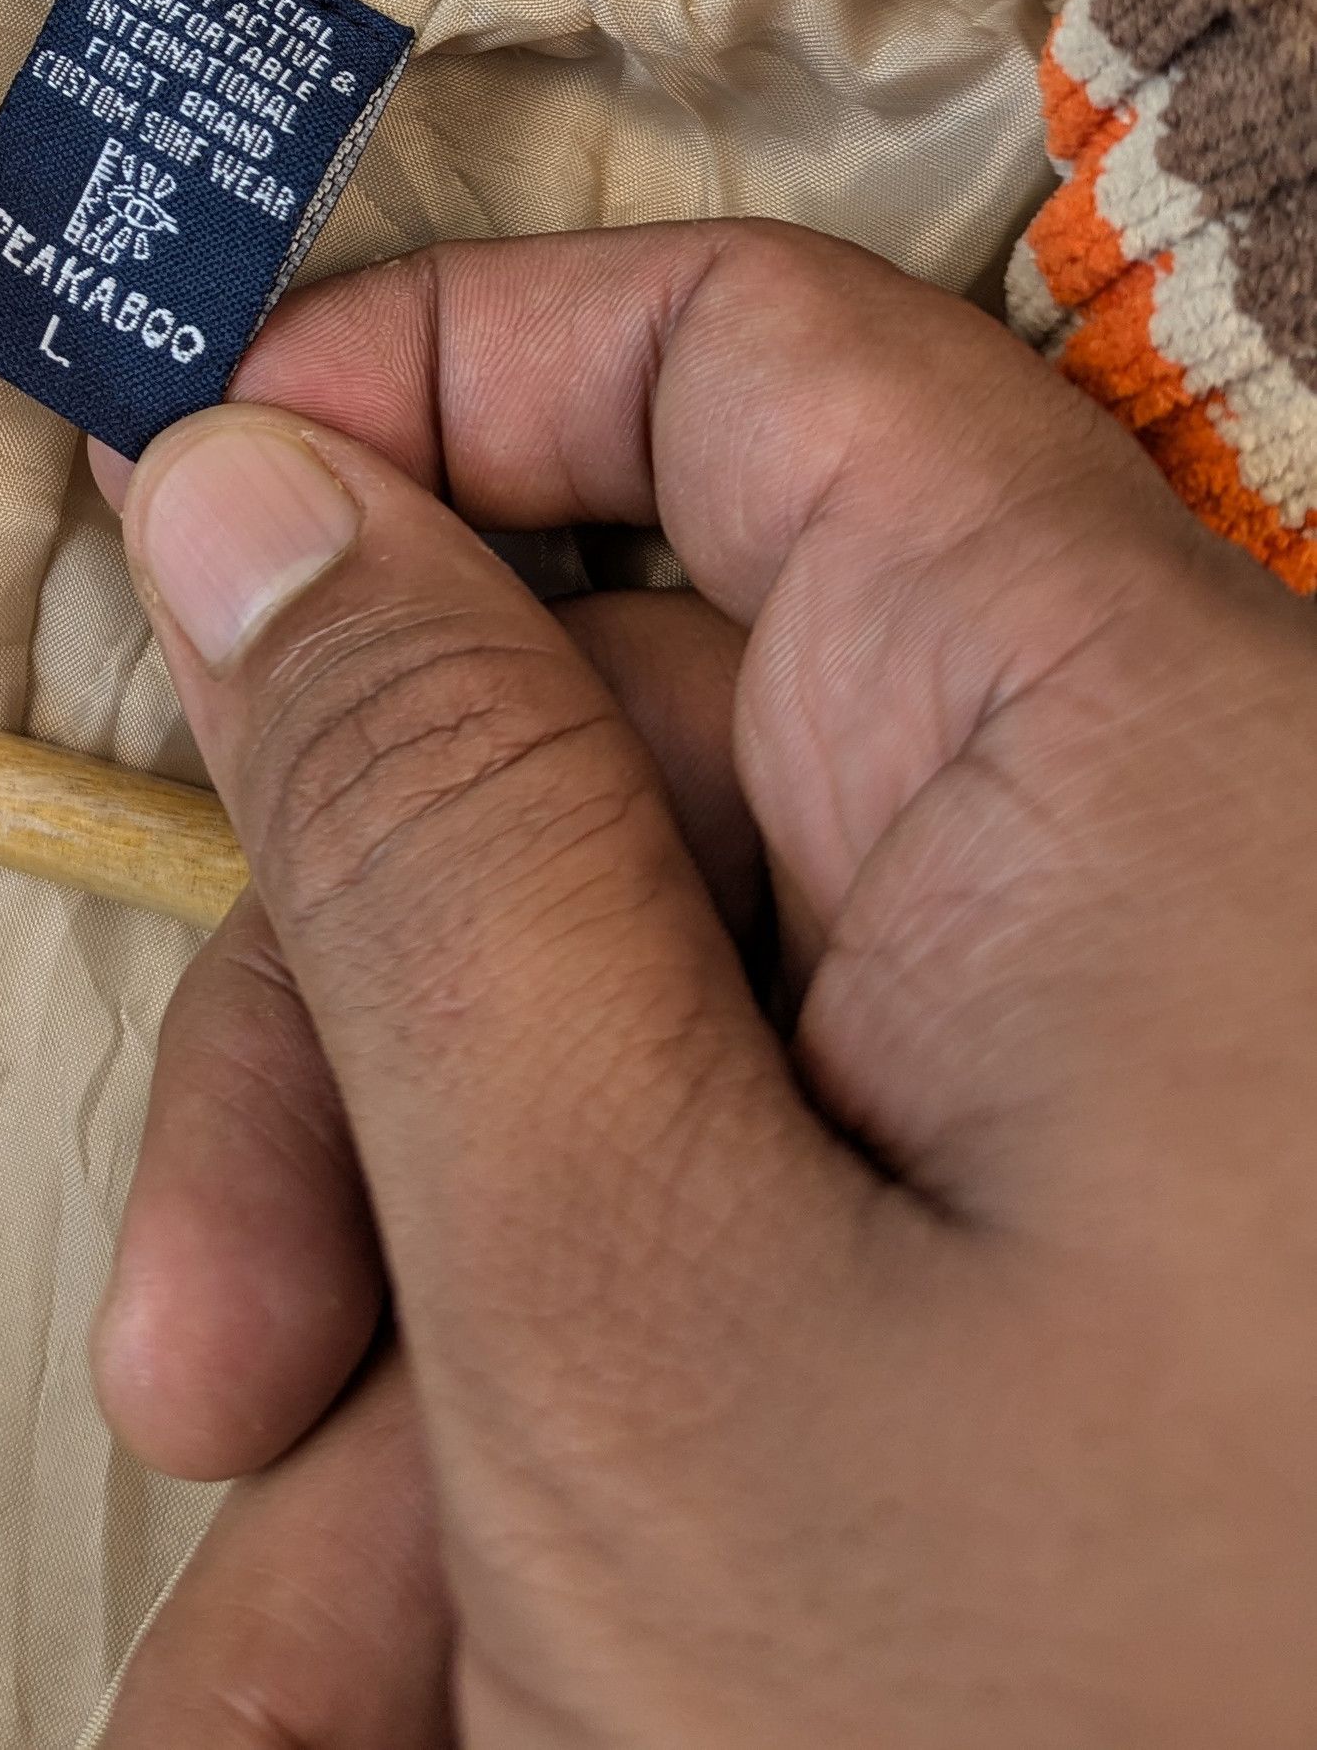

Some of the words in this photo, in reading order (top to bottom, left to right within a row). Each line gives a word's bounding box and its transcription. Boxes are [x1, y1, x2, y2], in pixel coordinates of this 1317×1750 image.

[84, 37, 167, 98] FIRST
[179, 90, 275, 160] BRAND
[223, 2, 331, 80] ACTIVE
[330, 70, 357, 97] &
[32, 49, 140, 131] CUSTOM
[139, 111, 209, 166] SURF
[209, 149, 296, 221] WEAR
[38, 313, 70, 368] L
